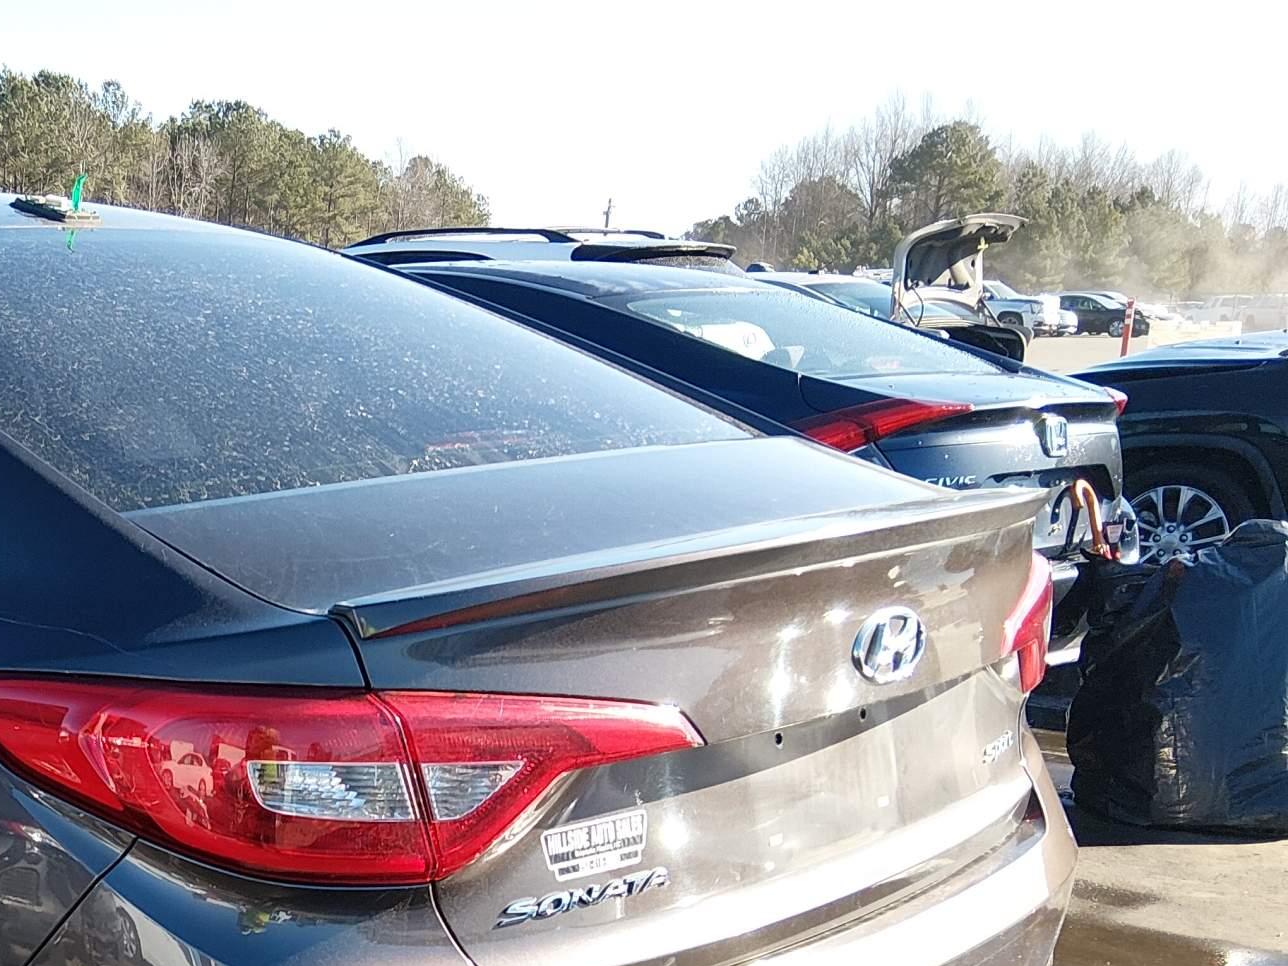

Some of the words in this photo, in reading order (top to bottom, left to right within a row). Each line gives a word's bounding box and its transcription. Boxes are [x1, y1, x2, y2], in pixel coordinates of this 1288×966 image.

[546, 827, 591, 855] HILLSIDE
[591, 820, 616, 847] AUTO
[492, 867, 669, 929] SONATA
